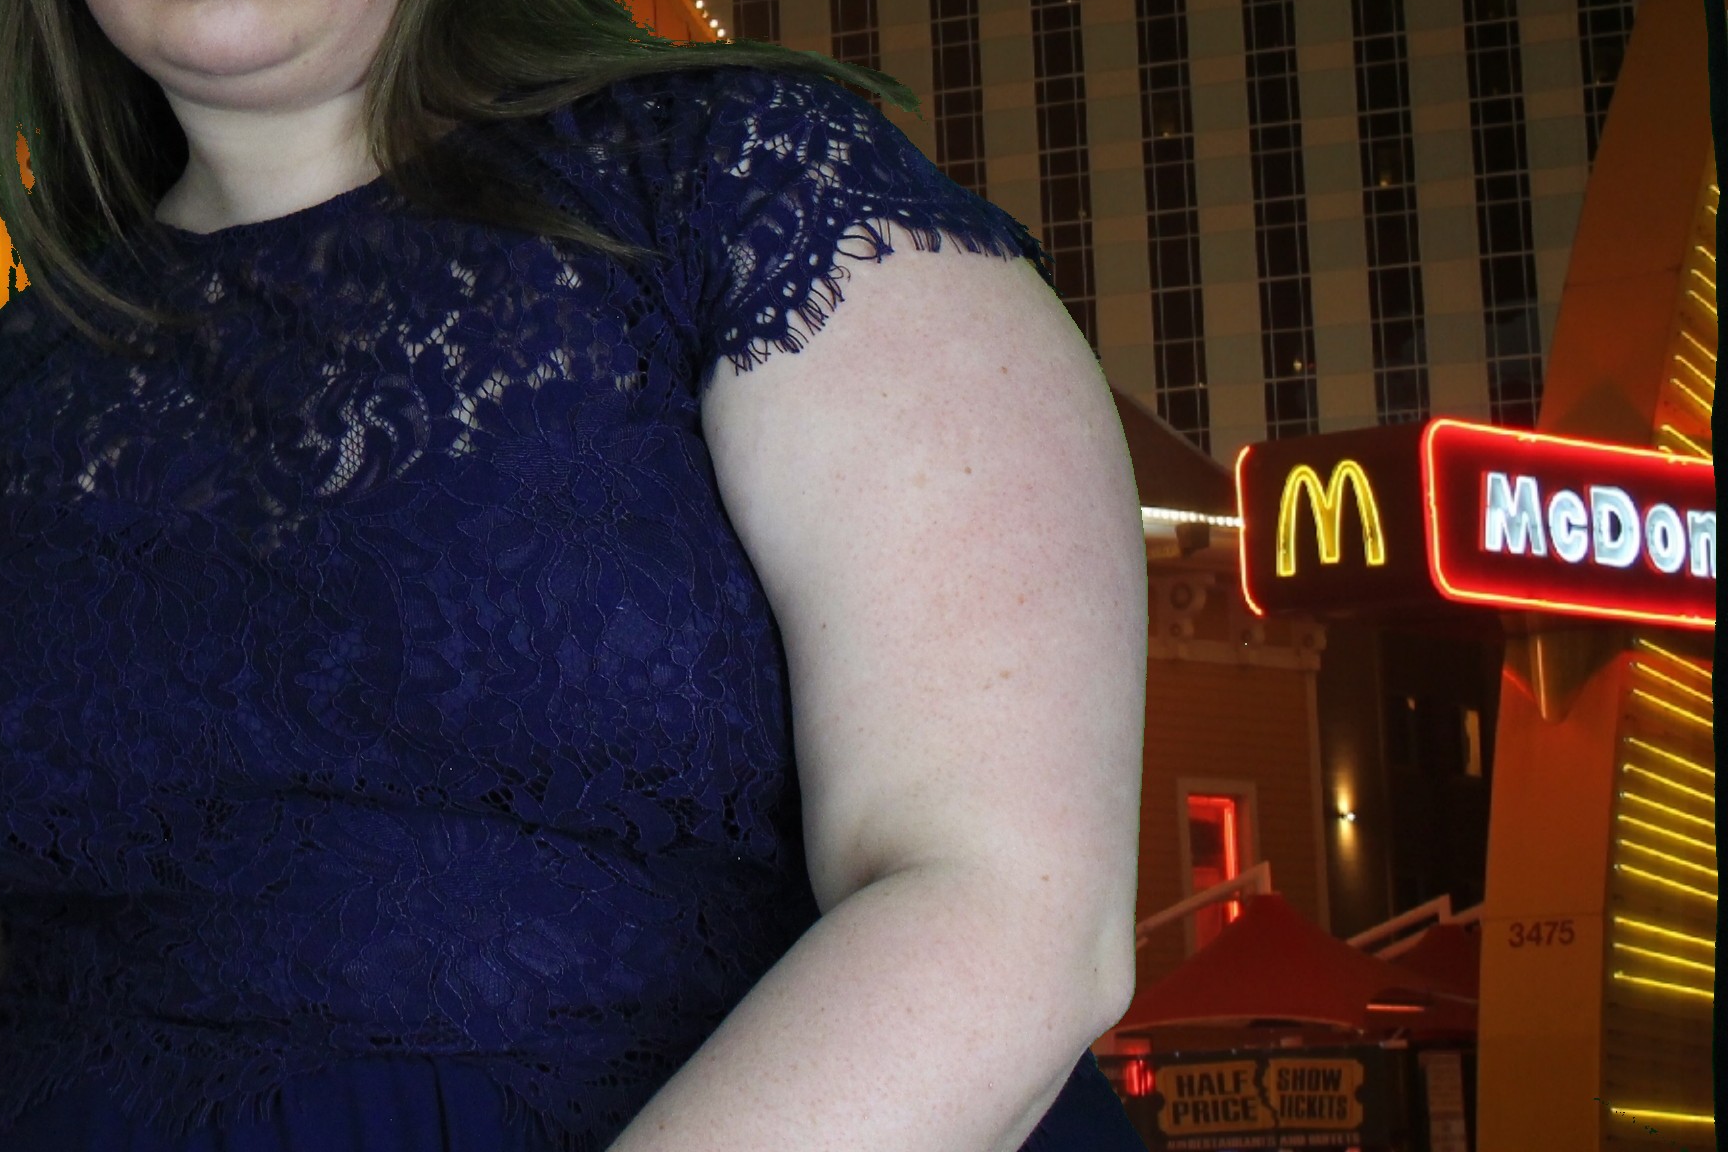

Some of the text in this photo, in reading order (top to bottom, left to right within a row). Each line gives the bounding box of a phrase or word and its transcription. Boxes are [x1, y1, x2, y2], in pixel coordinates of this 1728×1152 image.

[1482, 471, 1717, 579] McDon
[1508, 919, 1576, 948] 3475
[1175, 1069, 1249, 1098] HALF
[1276, 1066, 1342, 1092] SHOW
[1173, 1097, 1259, 1126] PRICE
[1279, 1095, 1348, 1121] TICKETS
